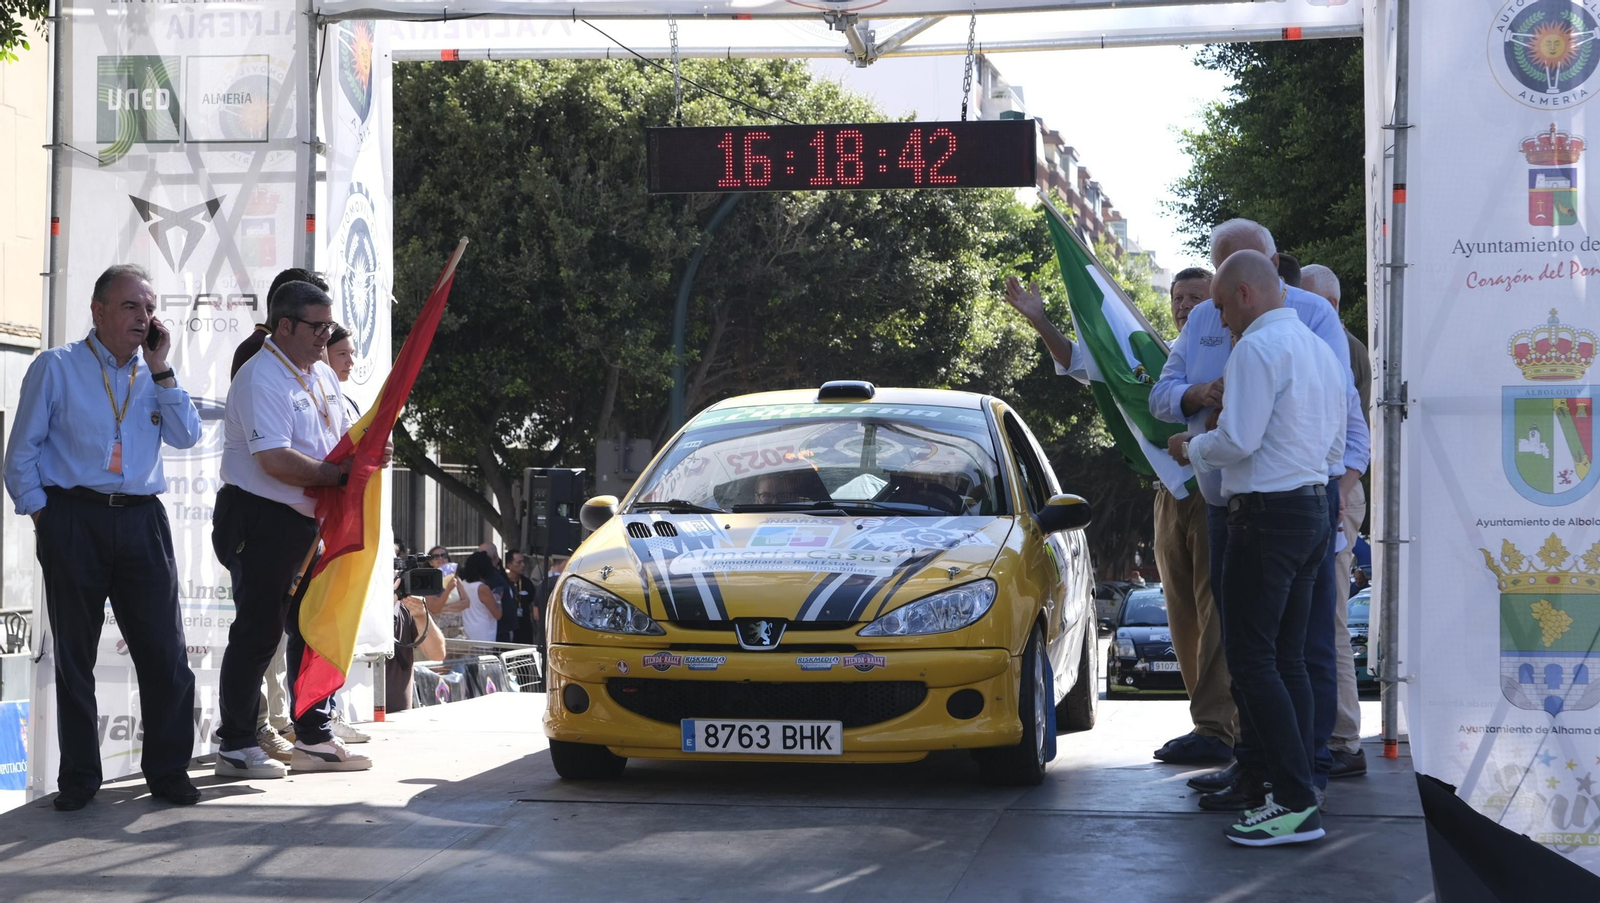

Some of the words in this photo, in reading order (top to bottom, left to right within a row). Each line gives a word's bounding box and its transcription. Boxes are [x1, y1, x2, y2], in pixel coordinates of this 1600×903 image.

[201, 91, 252, 105] ALMERÍA
[1519, 89, 1588, 106] ALMERIA
[717, 128, 957, 187] 16:18:42
[1452, 237, 1575, 257] Ayuntamiento
[1580, 237, 1600, 252] de
[1466, 265, 1534, 292] Corazón
[1538, 261, 1564, 280] del
[156, 293, 258, 312] PRA
[1525, 388, 1583, 397] ALBOLODUY
[1476, 517, 1550, 528] Ayuntamiento
[1552, 517, 1566, 527] de
[677, 549, 796, 563] Almería
[807, 549, 892, 564] Casas
[704, 724, 771, 750] 8763
[782, 725, 833, 750] BHK
[1458, 725, 1533, 735] Ayuntamiento
[1535, 725, 1548, 735] de
[1550, 725, 1592, 735] Alhama
